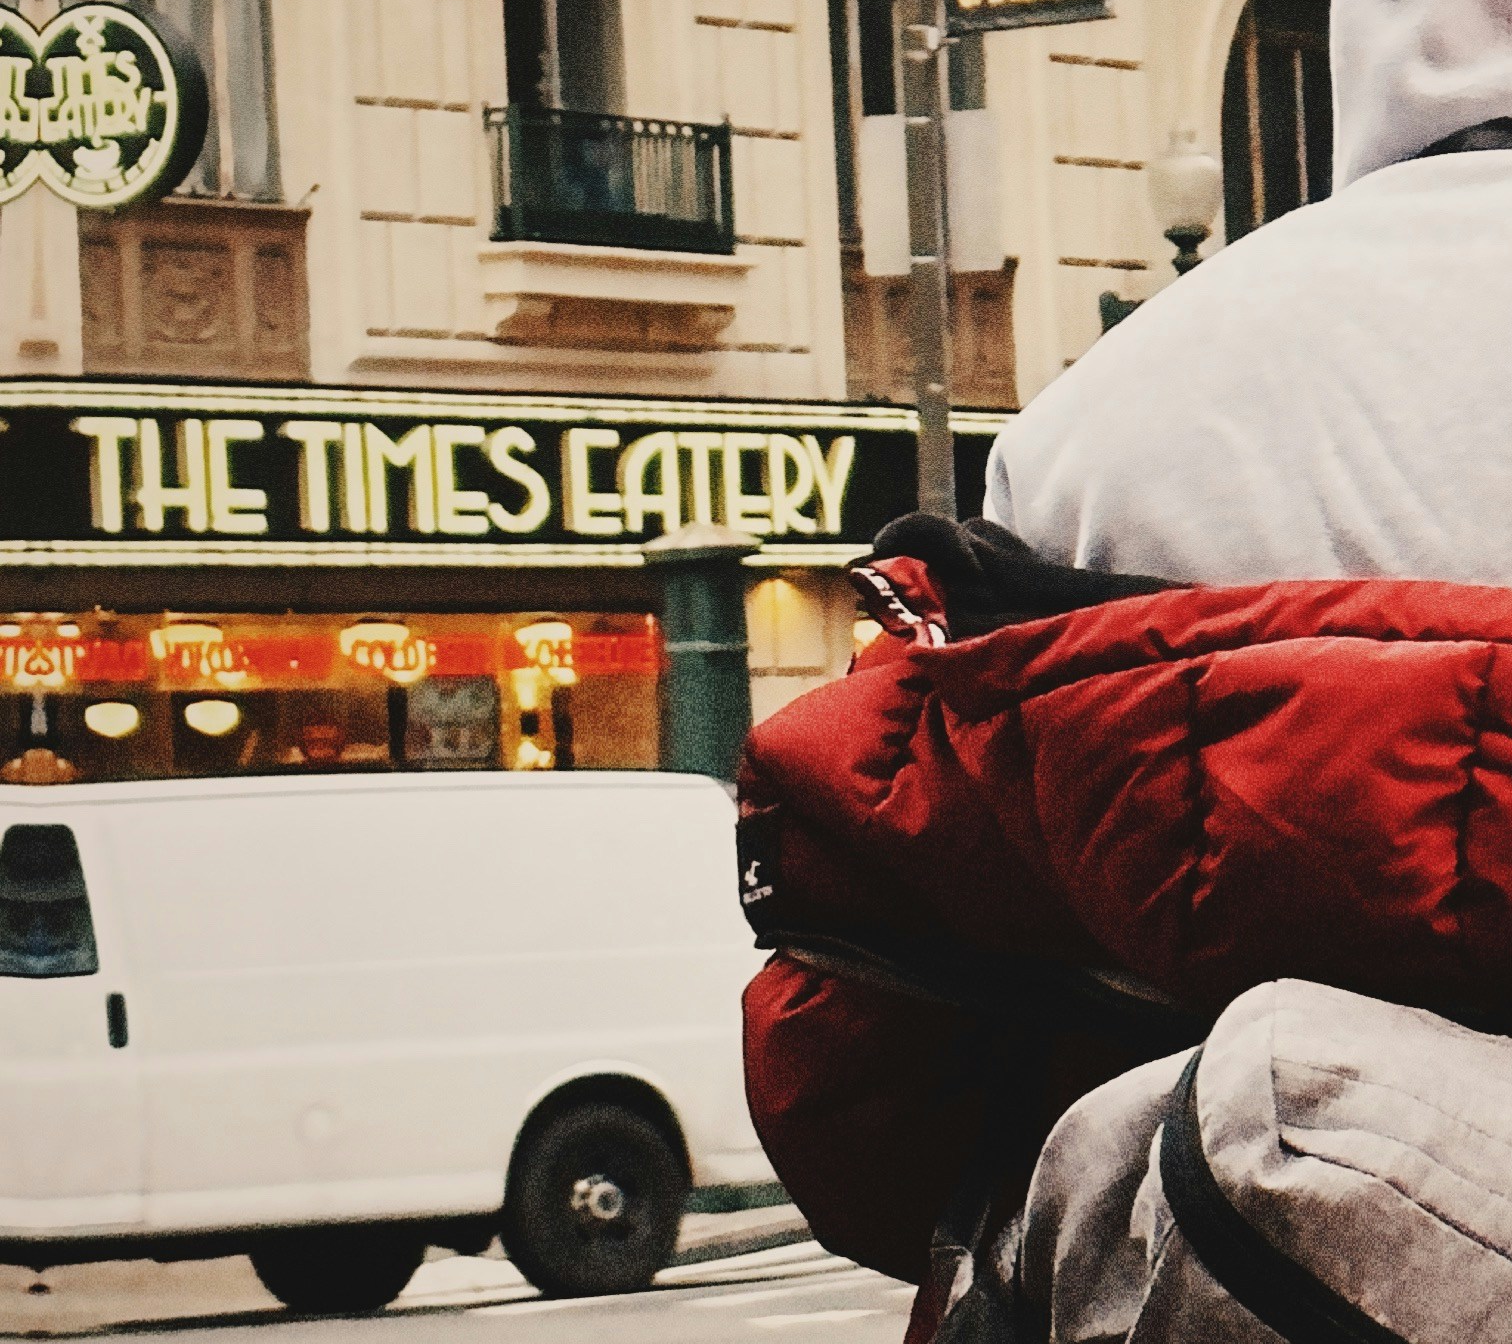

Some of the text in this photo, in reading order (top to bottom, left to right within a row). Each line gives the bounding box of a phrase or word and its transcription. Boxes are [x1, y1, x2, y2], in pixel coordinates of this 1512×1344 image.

[73, 416, 855, 536] THE TIMES EATERY
